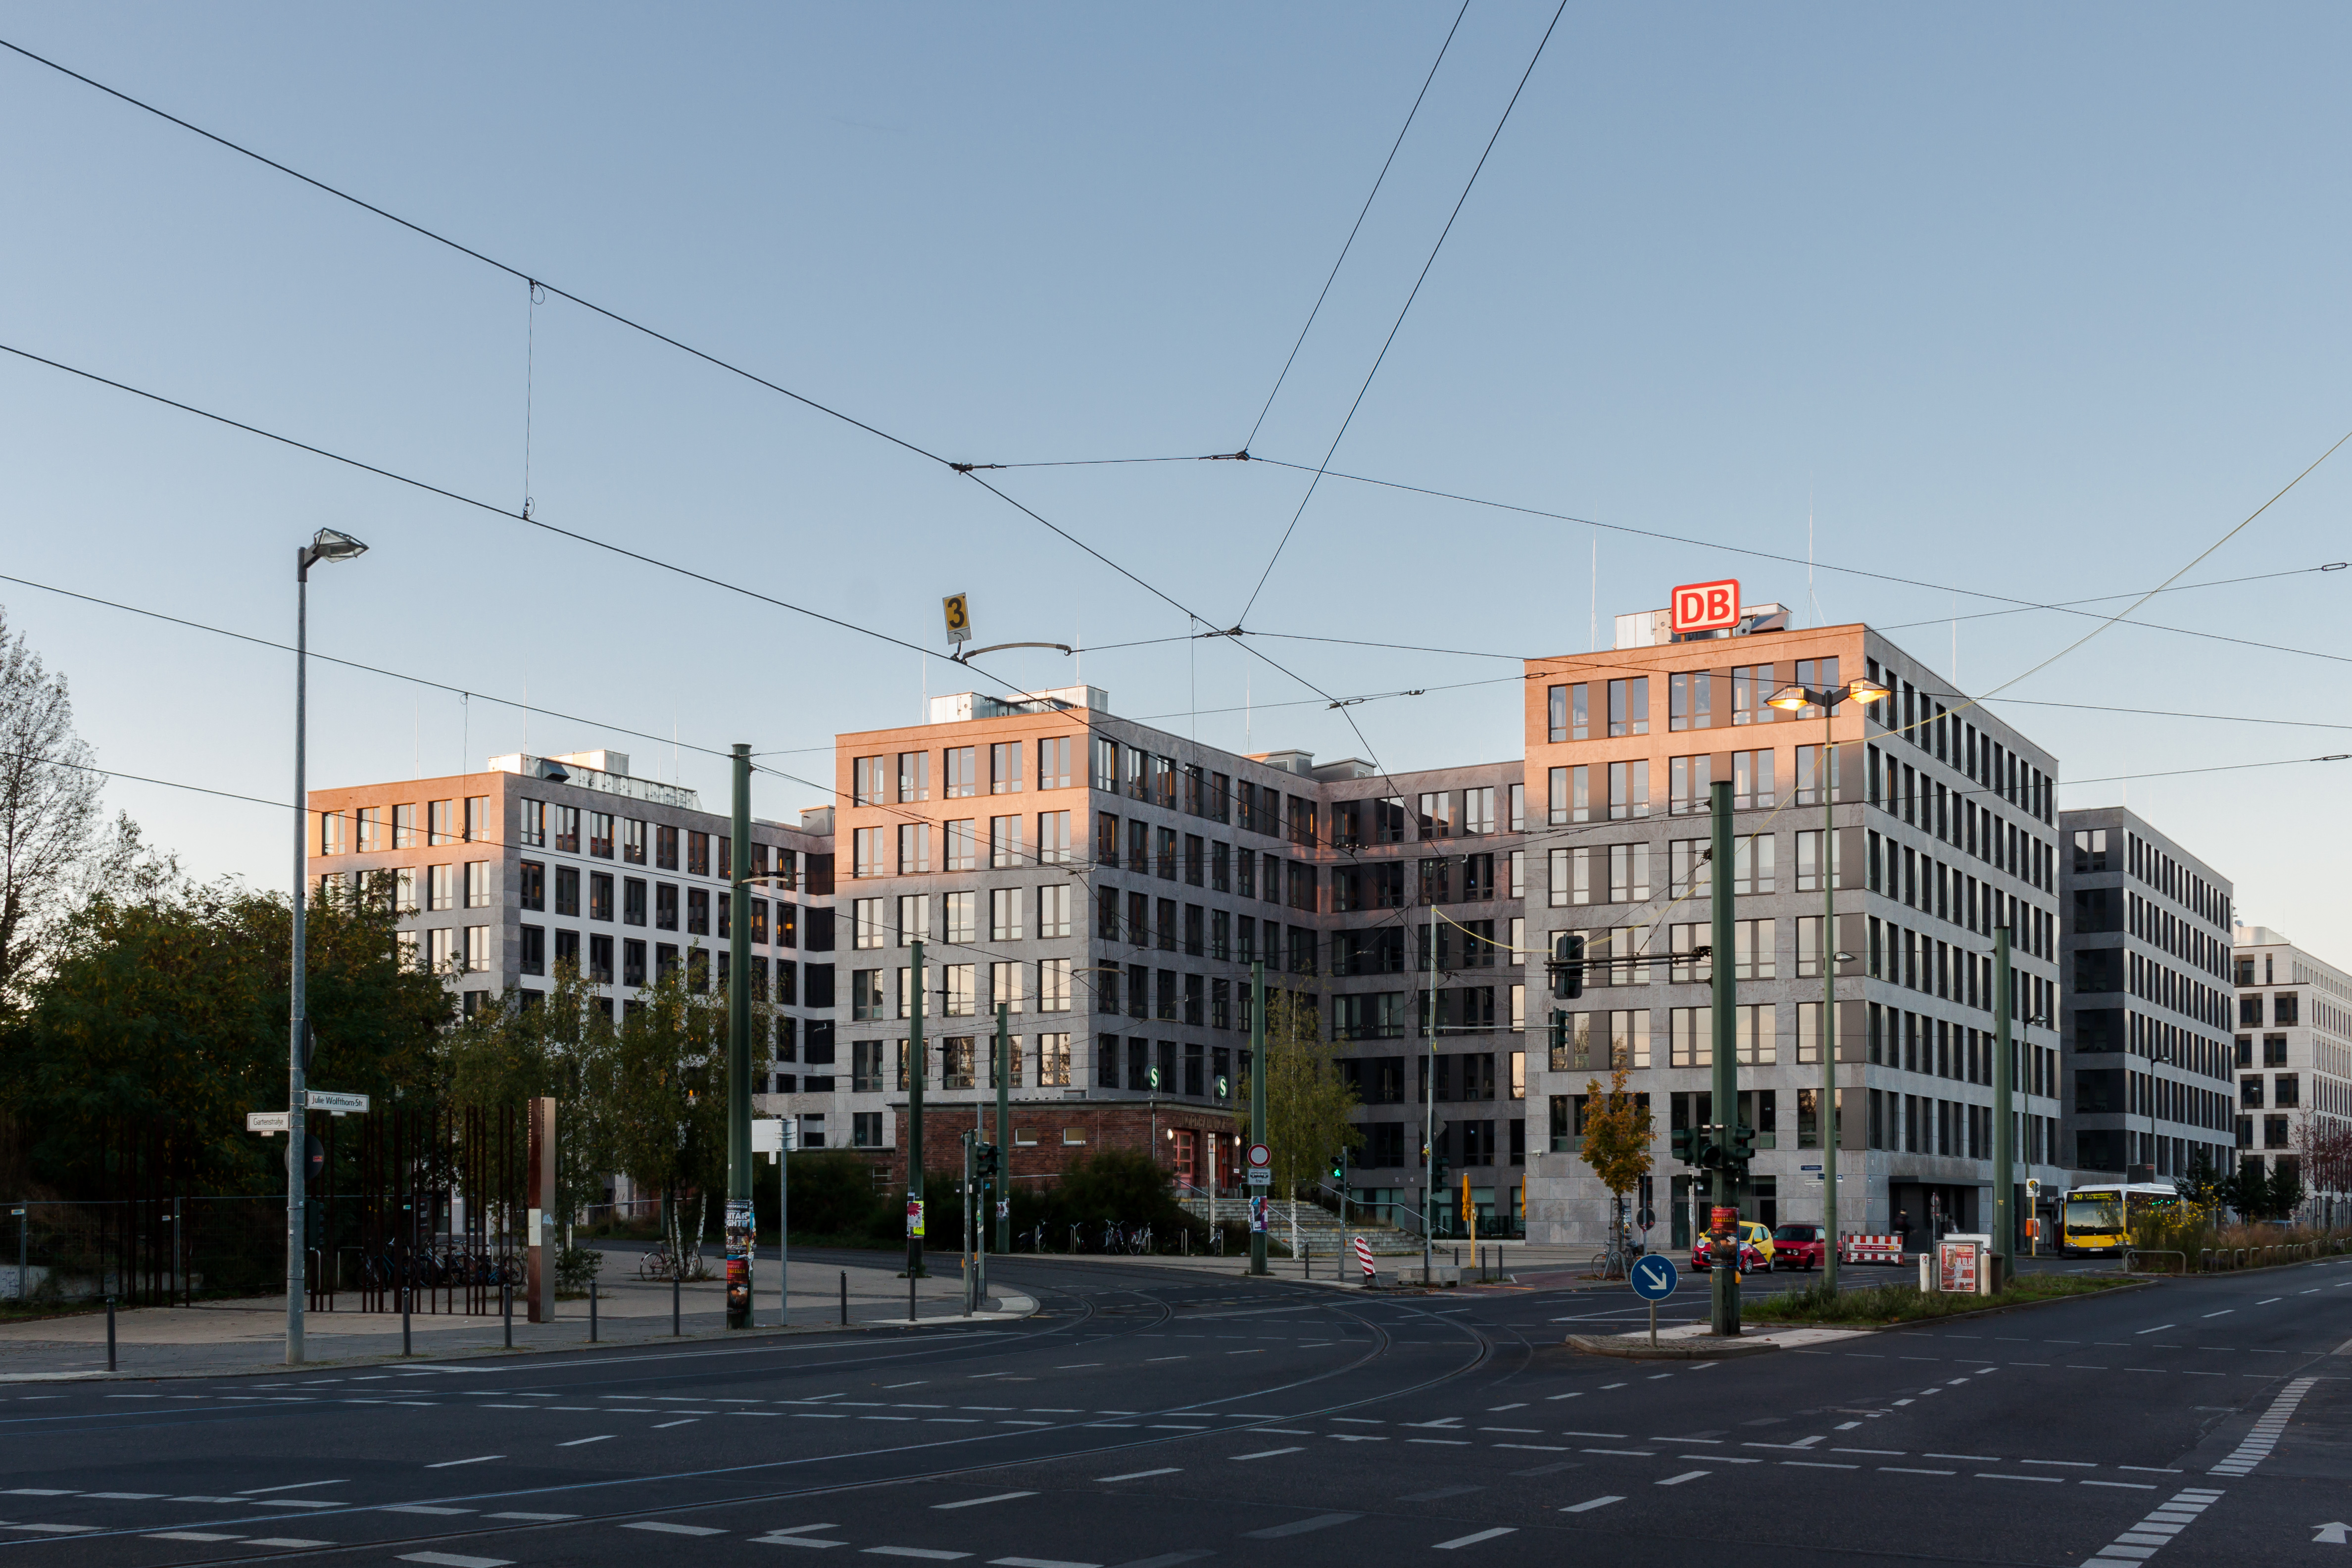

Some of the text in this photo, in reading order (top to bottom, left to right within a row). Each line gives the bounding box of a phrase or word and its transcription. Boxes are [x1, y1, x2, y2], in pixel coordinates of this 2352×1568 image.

[948, 598, 965, 628] 3
[1681, 589, 1730, 624] DB
[1151, 1068, 1158, 1087] S
[1220, 1078, 1226, 1096] S
[312, 1095, 324, 1104] Julie
[253, 1117, 284, 1127] Gartenstraße
